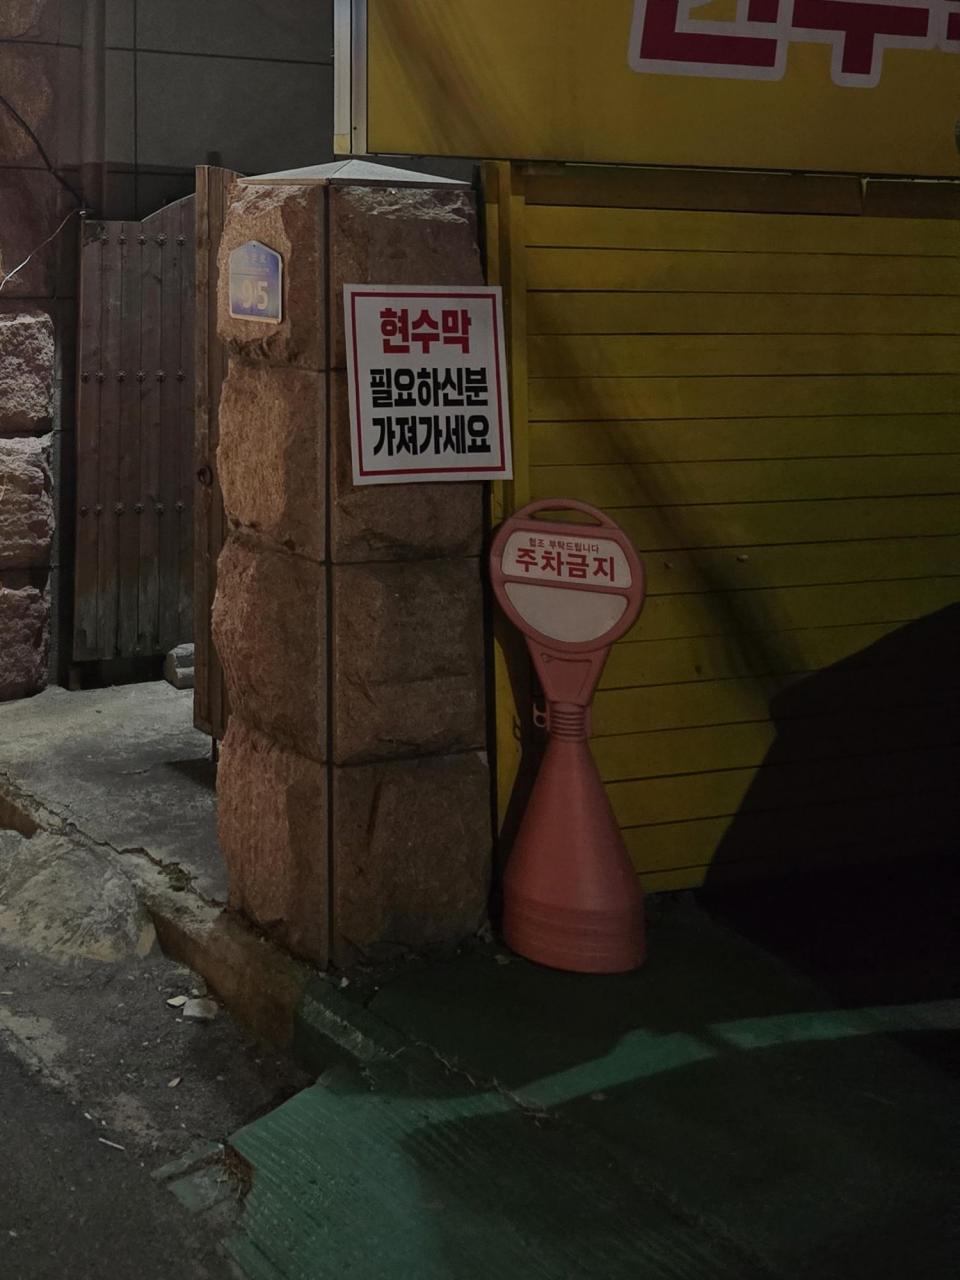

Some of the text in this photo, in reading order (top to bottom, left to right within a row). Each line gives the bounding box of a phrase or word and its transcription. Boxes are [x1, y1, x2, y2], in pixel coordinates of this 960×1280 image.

[379, 307, 471, 354] 현수막
[370, 367, 488, 407] 필요하신분
[373, 414, 491, 456] 가져가세요
[515, 547, 615, 582] 주차금지
[529, 537, 600, 554] 협조 부탁드립니다
